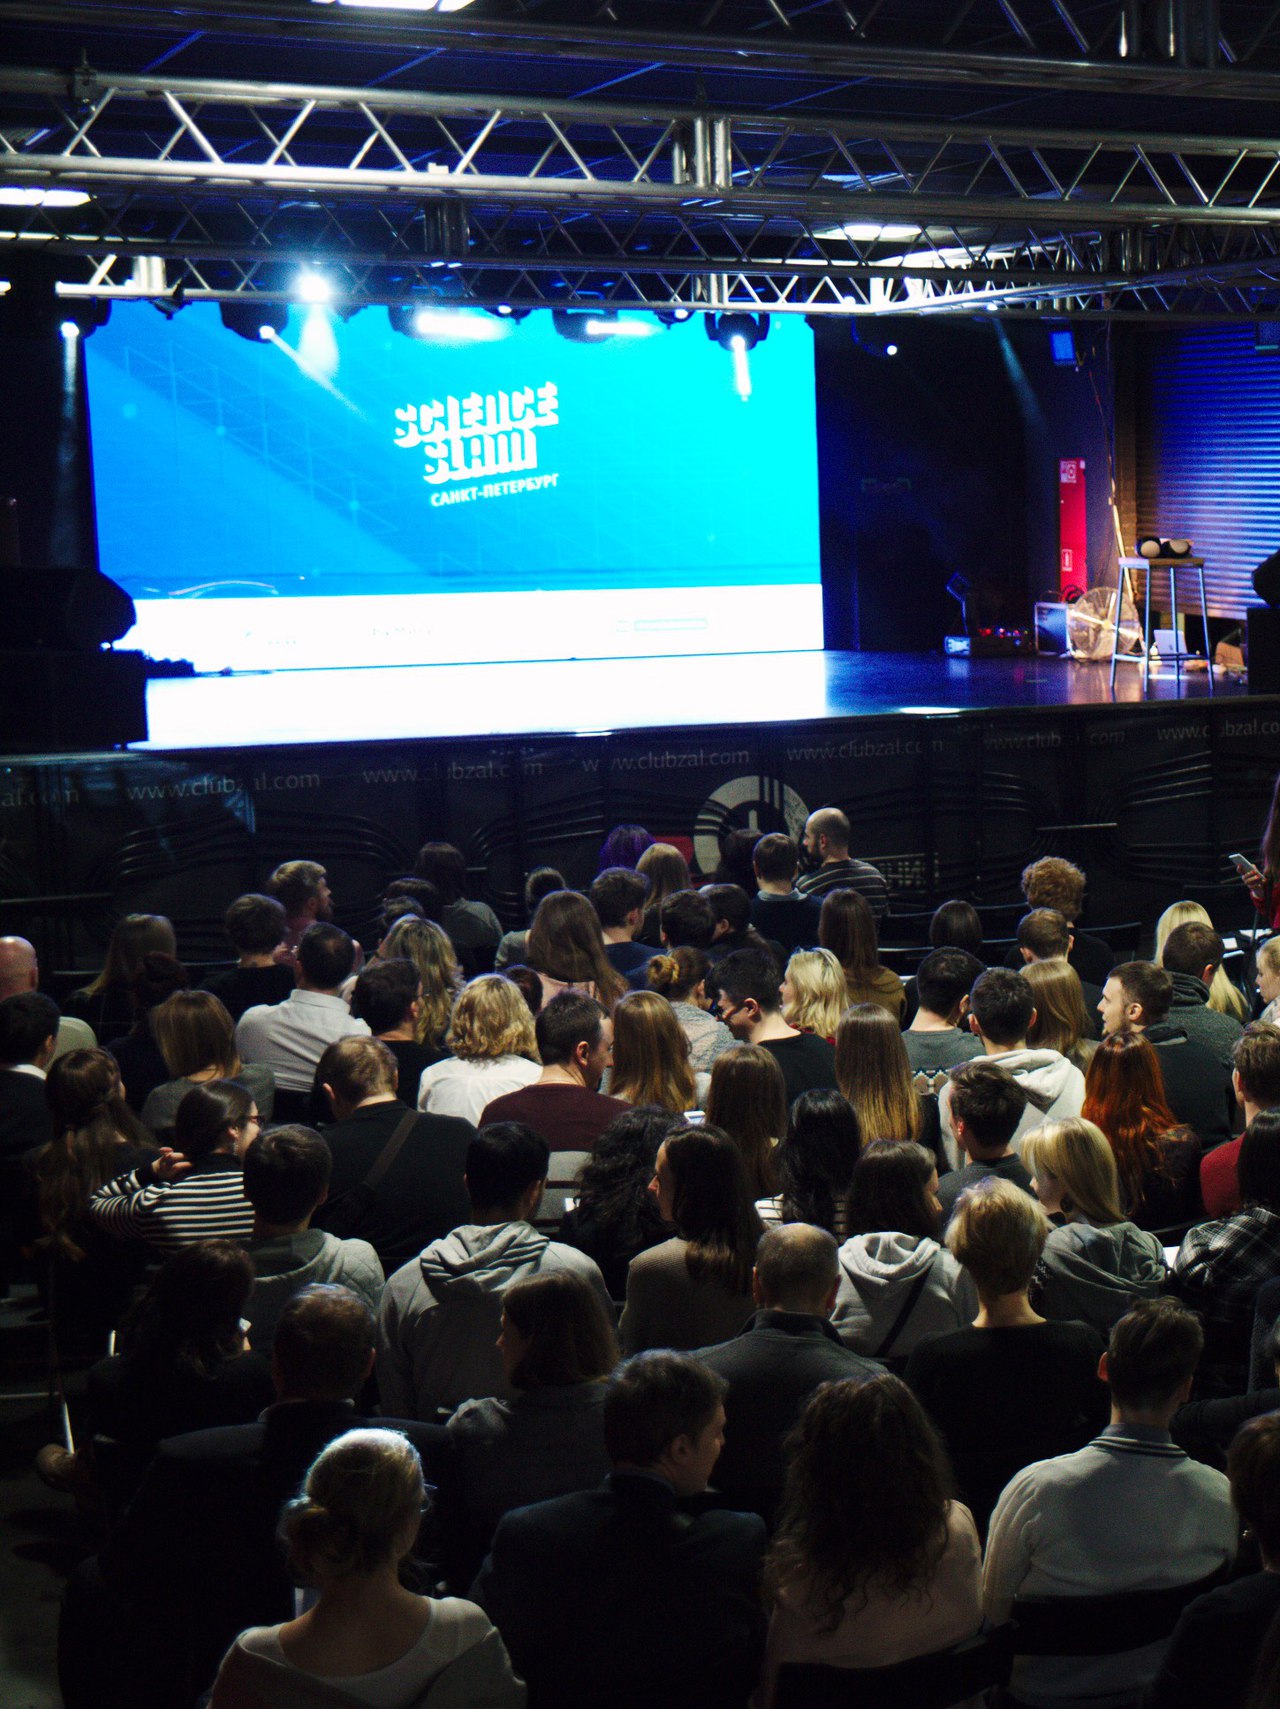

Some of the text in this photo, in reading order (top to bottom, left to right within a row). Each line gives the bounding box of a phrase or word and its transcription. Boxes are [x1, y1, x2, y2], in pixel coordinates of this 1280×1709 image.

[393, 381, 559, 448] SCIENCE
[430, 473, 560, 507] САНКТ-ПЕТЕРБУРГ
[126, 771, 321, 801] www.clubl.com
